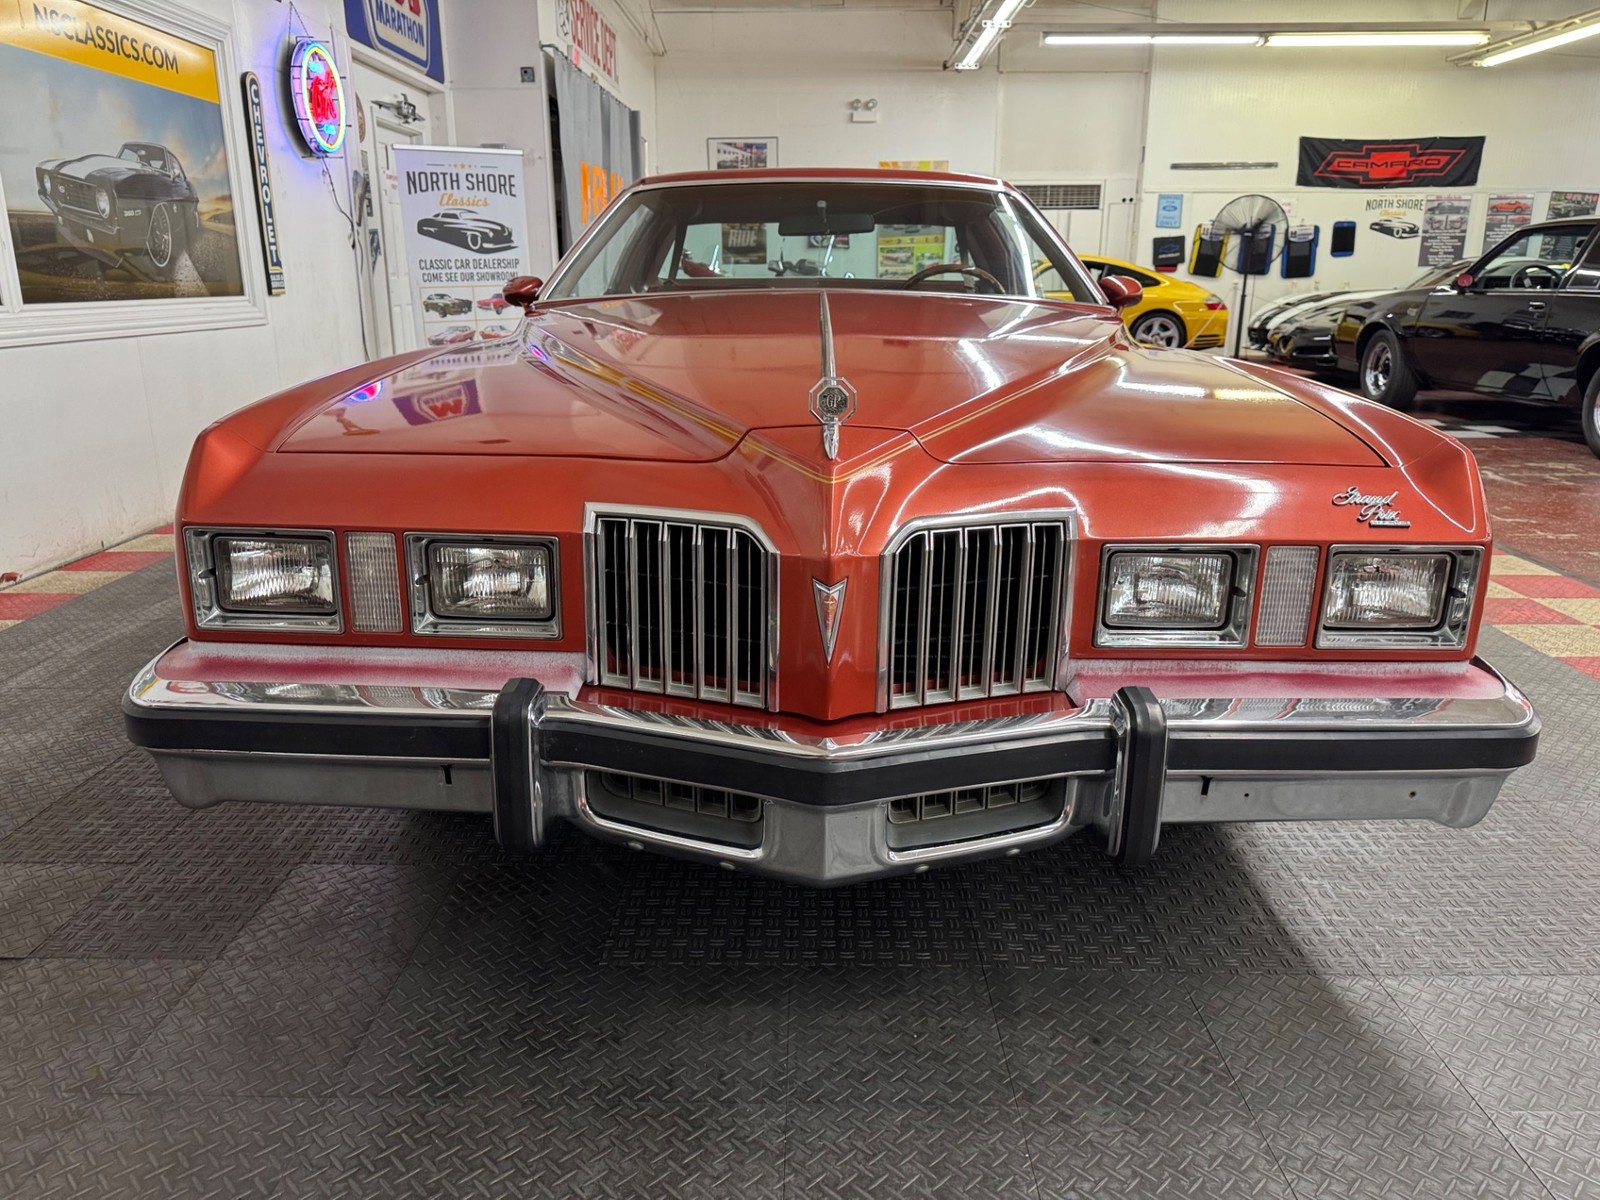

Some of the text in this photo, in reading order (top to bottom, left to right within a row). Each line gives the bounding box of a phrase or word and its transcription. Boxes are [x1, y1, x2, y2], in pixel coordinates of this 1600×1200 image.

[375, 0, 425, 47] MARATHON
[33, 3, 180, 74] NSCLASSICS.COM
[1336, 158, 1442, 169] CAMARO
[250, 84, 278, 263] CHEVROLET
[406, 170, 460, 195] NORTH
[465, 173, 517, 197] SHORE
[438, 192, 489, 207] Classics
[1365, 199, 1424, 211] NORTH SHORE
[727, 229, 758, 248] RIDE
[419, 258, 520, 270] CLASSIC CAR DEALERSHIP
[422, 272, 444, 282] COME
[445, 272, 459, 282] SEE
[460, 272, 475, 282] OUR
[1332, 486, 1399, 506] Grand
